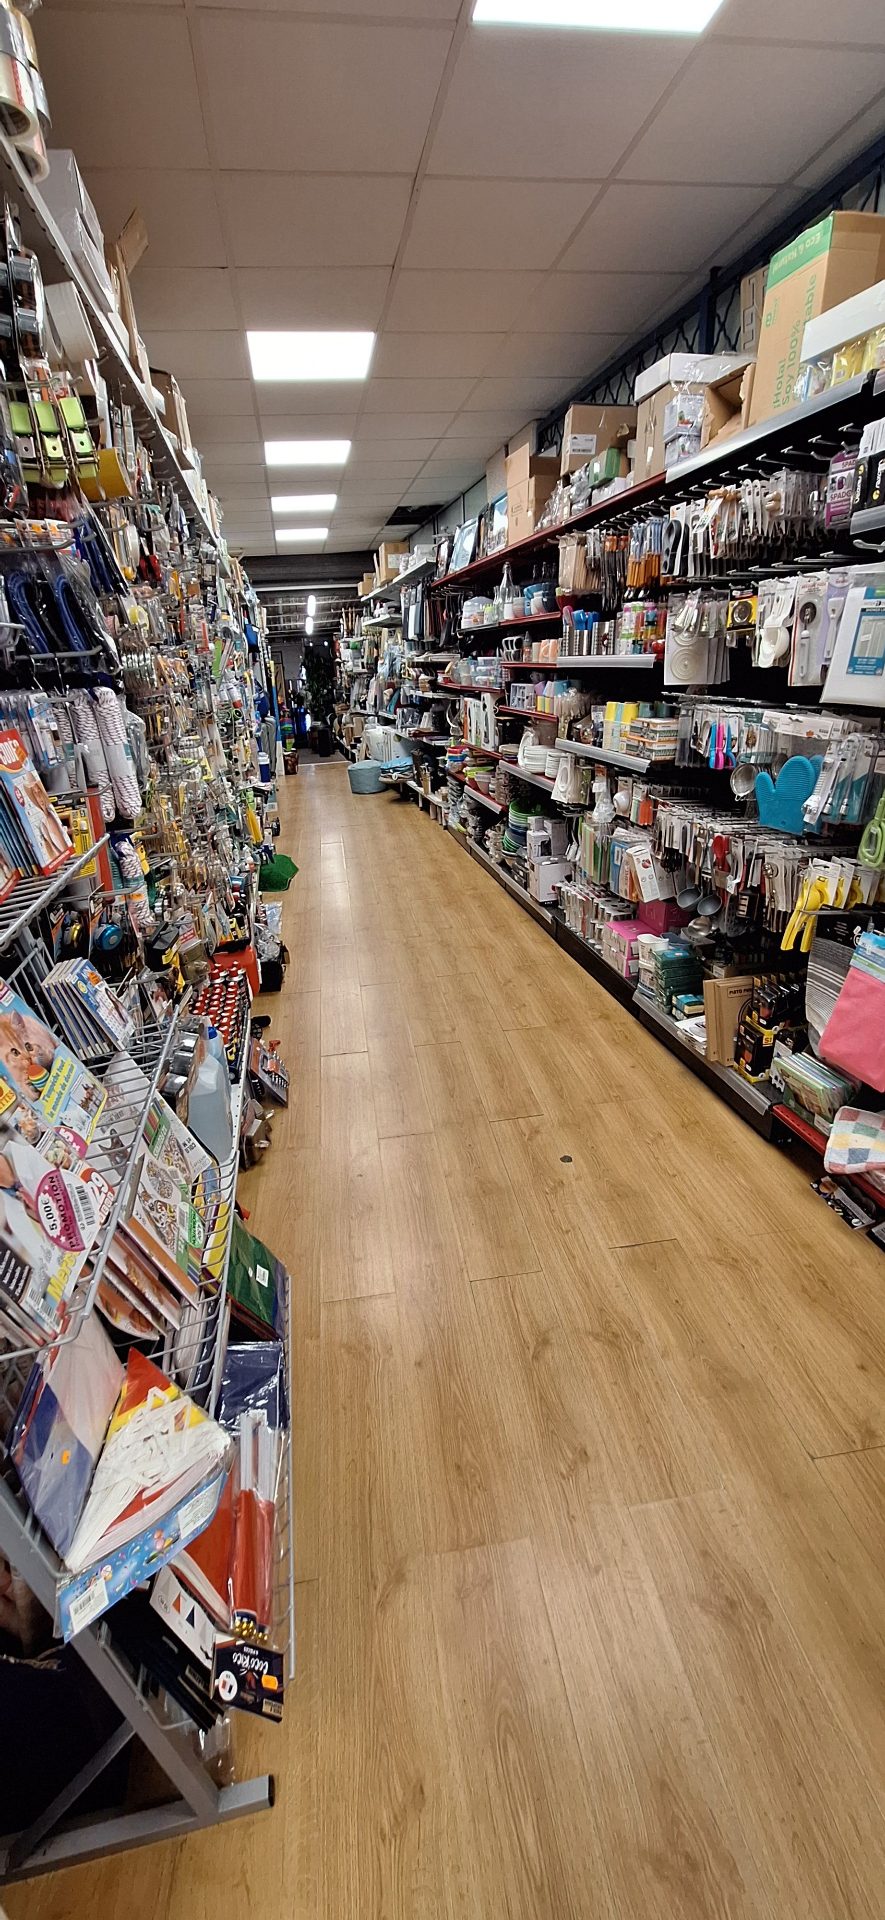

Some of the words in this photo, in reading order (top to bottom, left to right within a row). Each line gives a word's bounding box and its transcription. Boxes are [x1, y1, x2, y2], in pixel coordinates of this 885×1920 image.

[787, 319, 801, 368] 100%
[782, 374, 795, 406] Soy
[41, 1198, 57, 1231] 5,00€
[48, 1176, 76, 1249] PROMOTION
